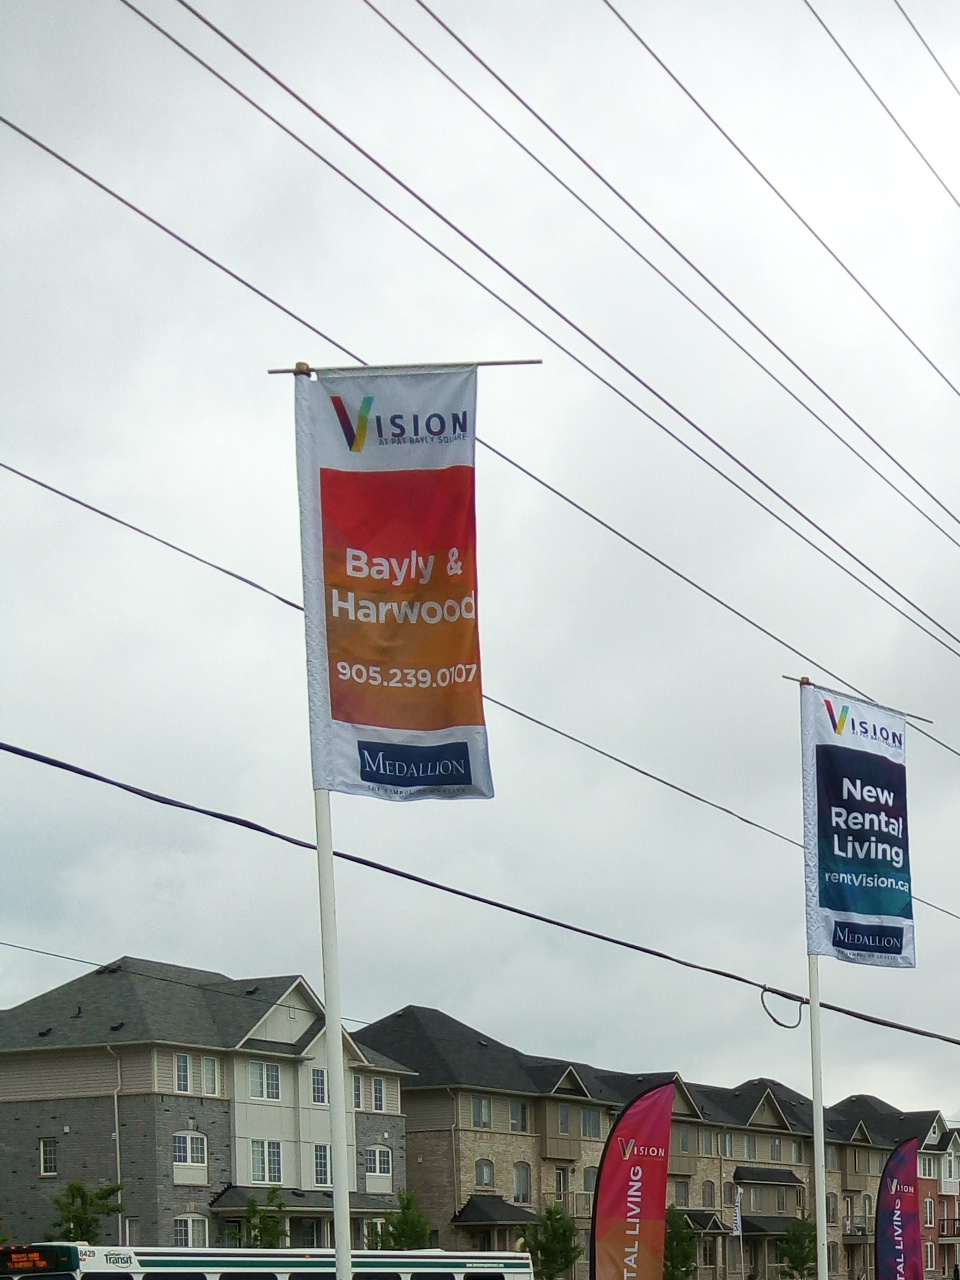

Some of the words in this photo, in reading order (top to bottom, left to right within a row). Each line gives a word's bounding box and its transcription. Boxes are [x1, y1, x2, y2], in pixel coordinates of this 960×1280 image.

[330, 396, 467, 452] VISION
[346, 548, 435, 586] Bayly
[446, 547, 462, 576] &
[332, 588, 475, 623] Harwood
[336, 661, 477, 688] 905.239.0107
[824, 699, 903, 746] VISION
[362, 750, 465, 777] MEDALLION
[842, 777, 894, 807] New
[831, 806, 903, 838] Rental
[834, 833, 904, 868] Living
[825, 872, 910, 893] rentVision.ca
[836, 926, 902, 948] MEDALLION
[618, 1137, 665, 1160] VISION
[626, 1165, 643, 1235] LIVING
[103, 1253, 133, 1264] Transit
